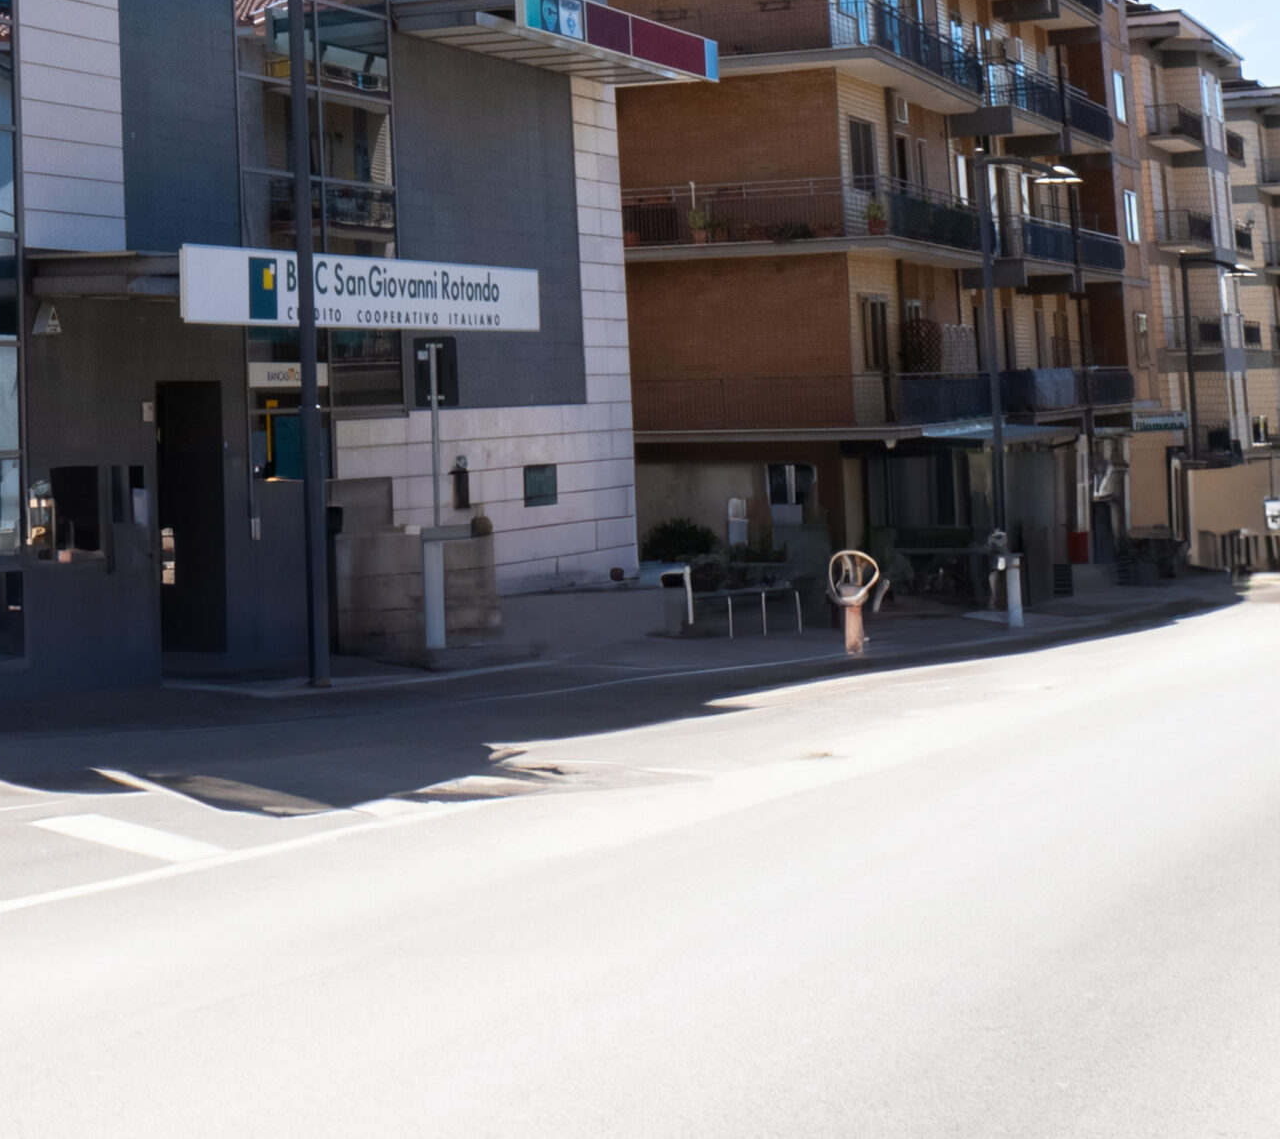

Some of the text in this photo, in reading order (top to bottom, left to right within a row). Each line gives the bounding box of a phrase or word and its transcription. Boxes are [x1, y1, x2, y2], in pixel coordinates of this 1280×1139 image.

[286, 259, 328, 294] BC
[441, 270, 500, 302] Rotondo
[287, 306, 501, 326] CDITO COOPERATIVO ITALIANO
